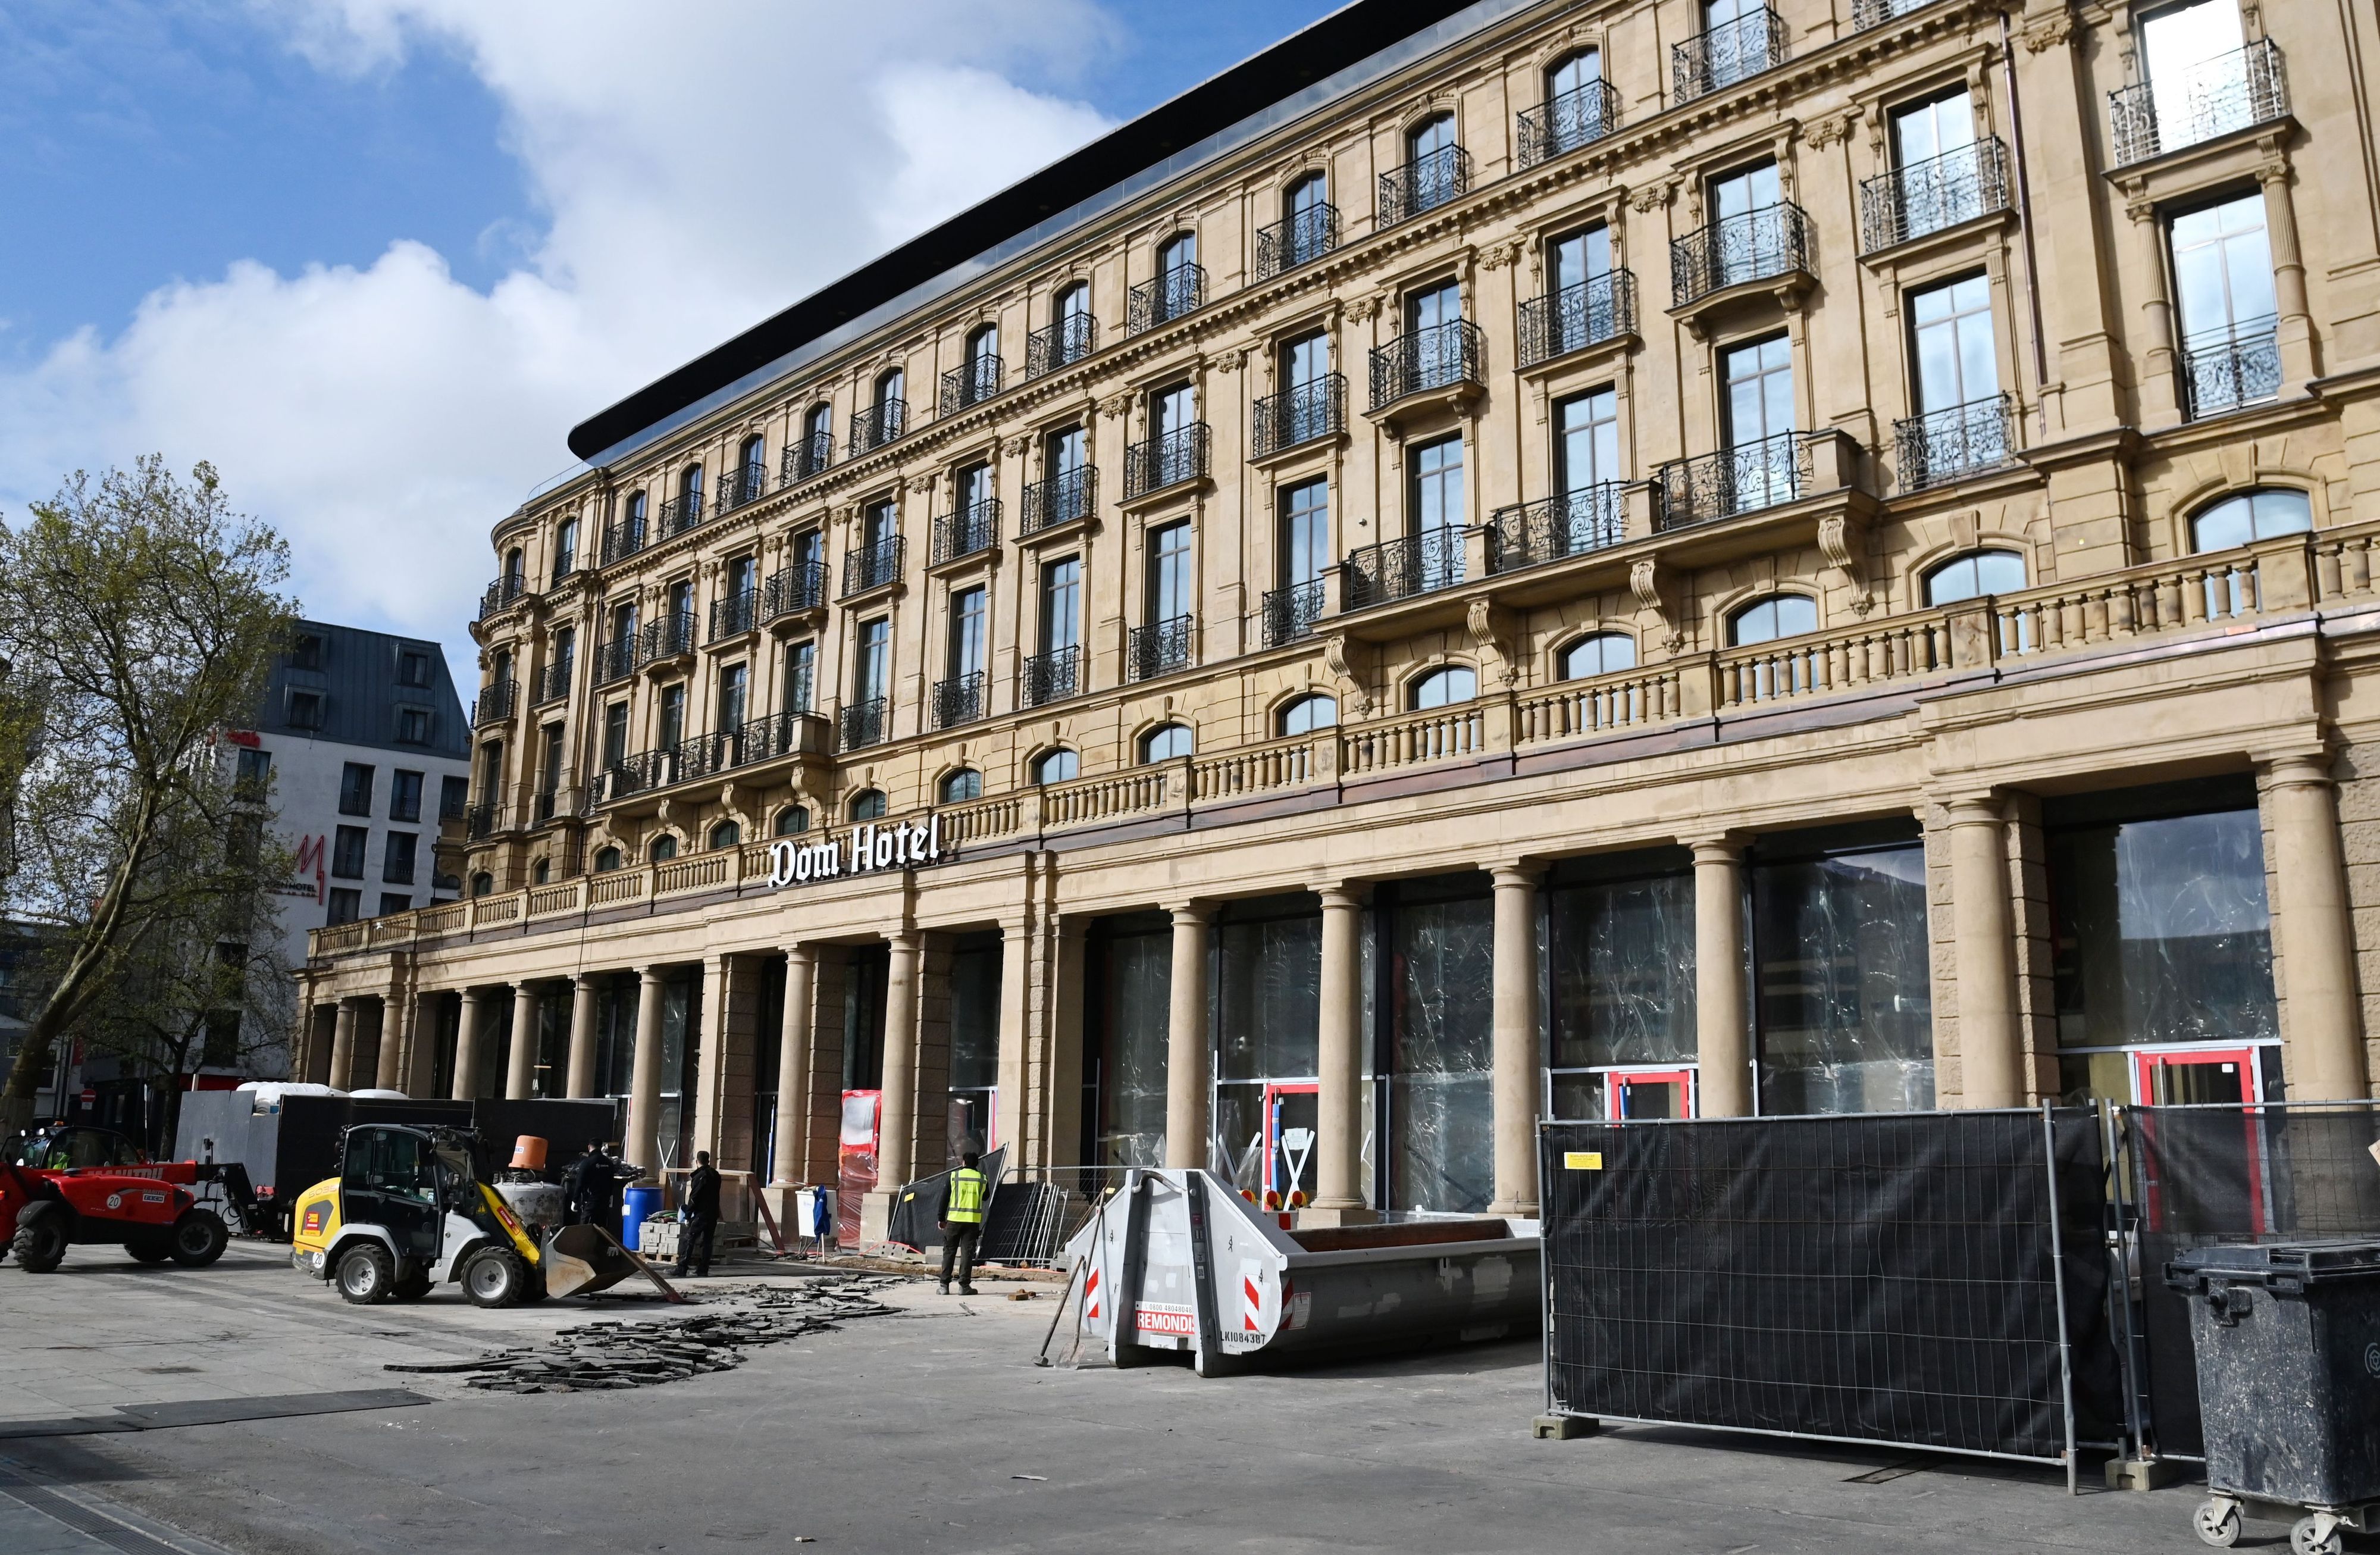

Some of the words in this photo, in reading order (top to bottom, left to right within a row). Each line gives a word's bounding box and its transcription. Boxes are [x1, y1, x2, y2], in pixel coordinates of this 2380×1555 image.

[768, 840, 840, 887] Dom
[851, 814, 941, 872] Hotel
[289, 883, 316, 892] HOTEL
[109, 1196, 119, 1206] 20
[315, 1253, 322, 1265] 20
[1164, 1305, 1192, 1313] 48048048
